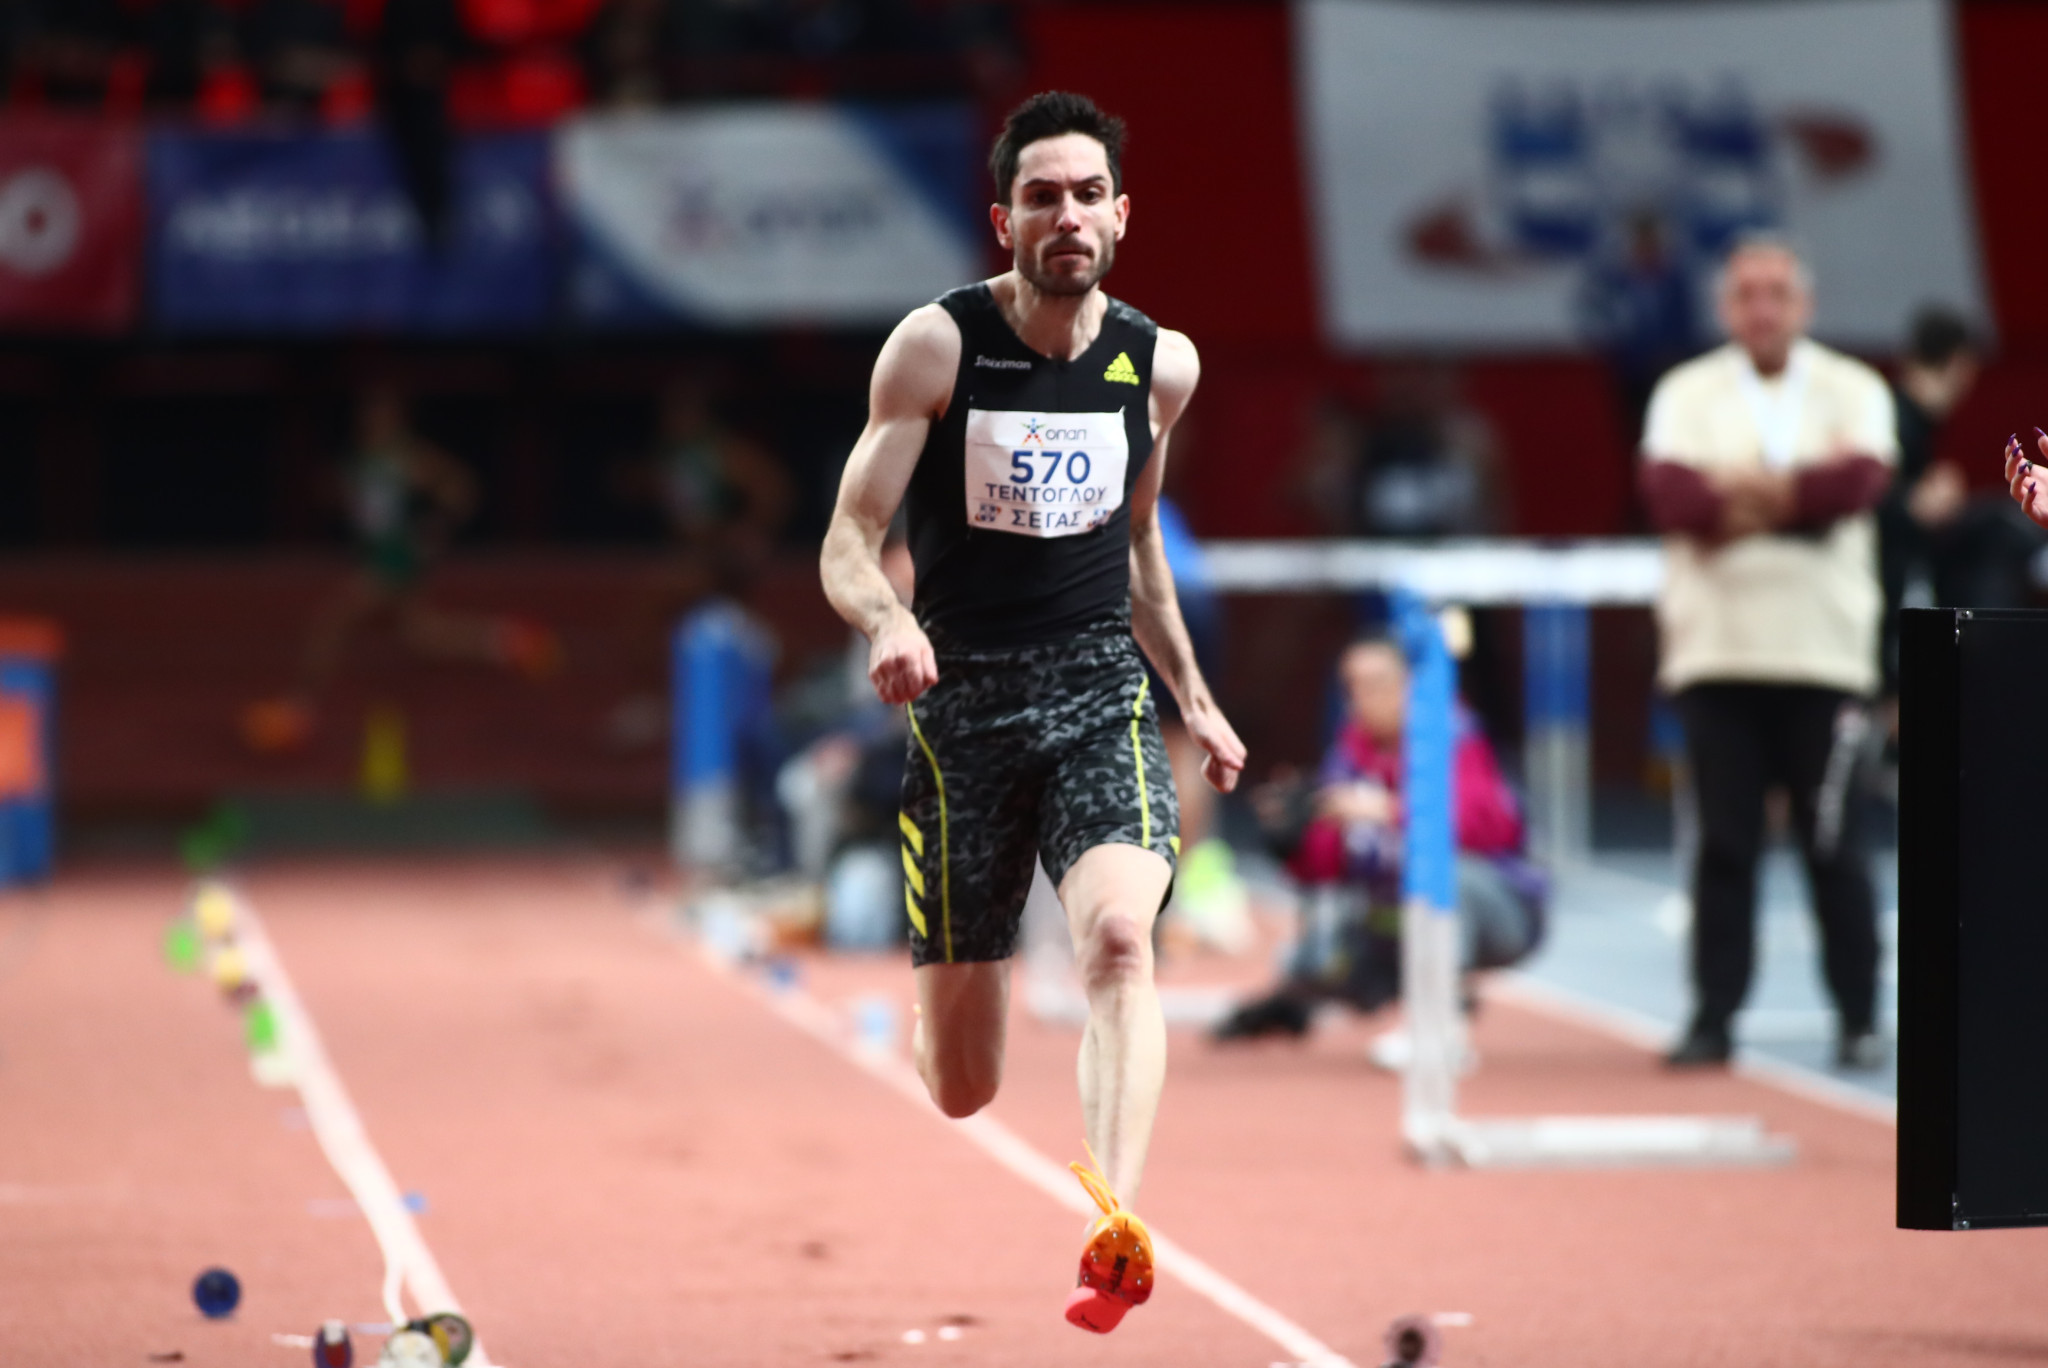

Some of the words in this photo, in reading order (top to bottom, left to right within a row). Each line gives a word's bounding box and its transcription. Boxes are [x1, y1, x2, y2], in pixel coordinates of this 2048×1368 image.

[1009, 450, 1090, 484] 570
[985, 483, 1107, 503] ΤΕΝΤΟΓΛΟΥ
[1011, 509, 1083, 529] ΣΕΓΑΣ
